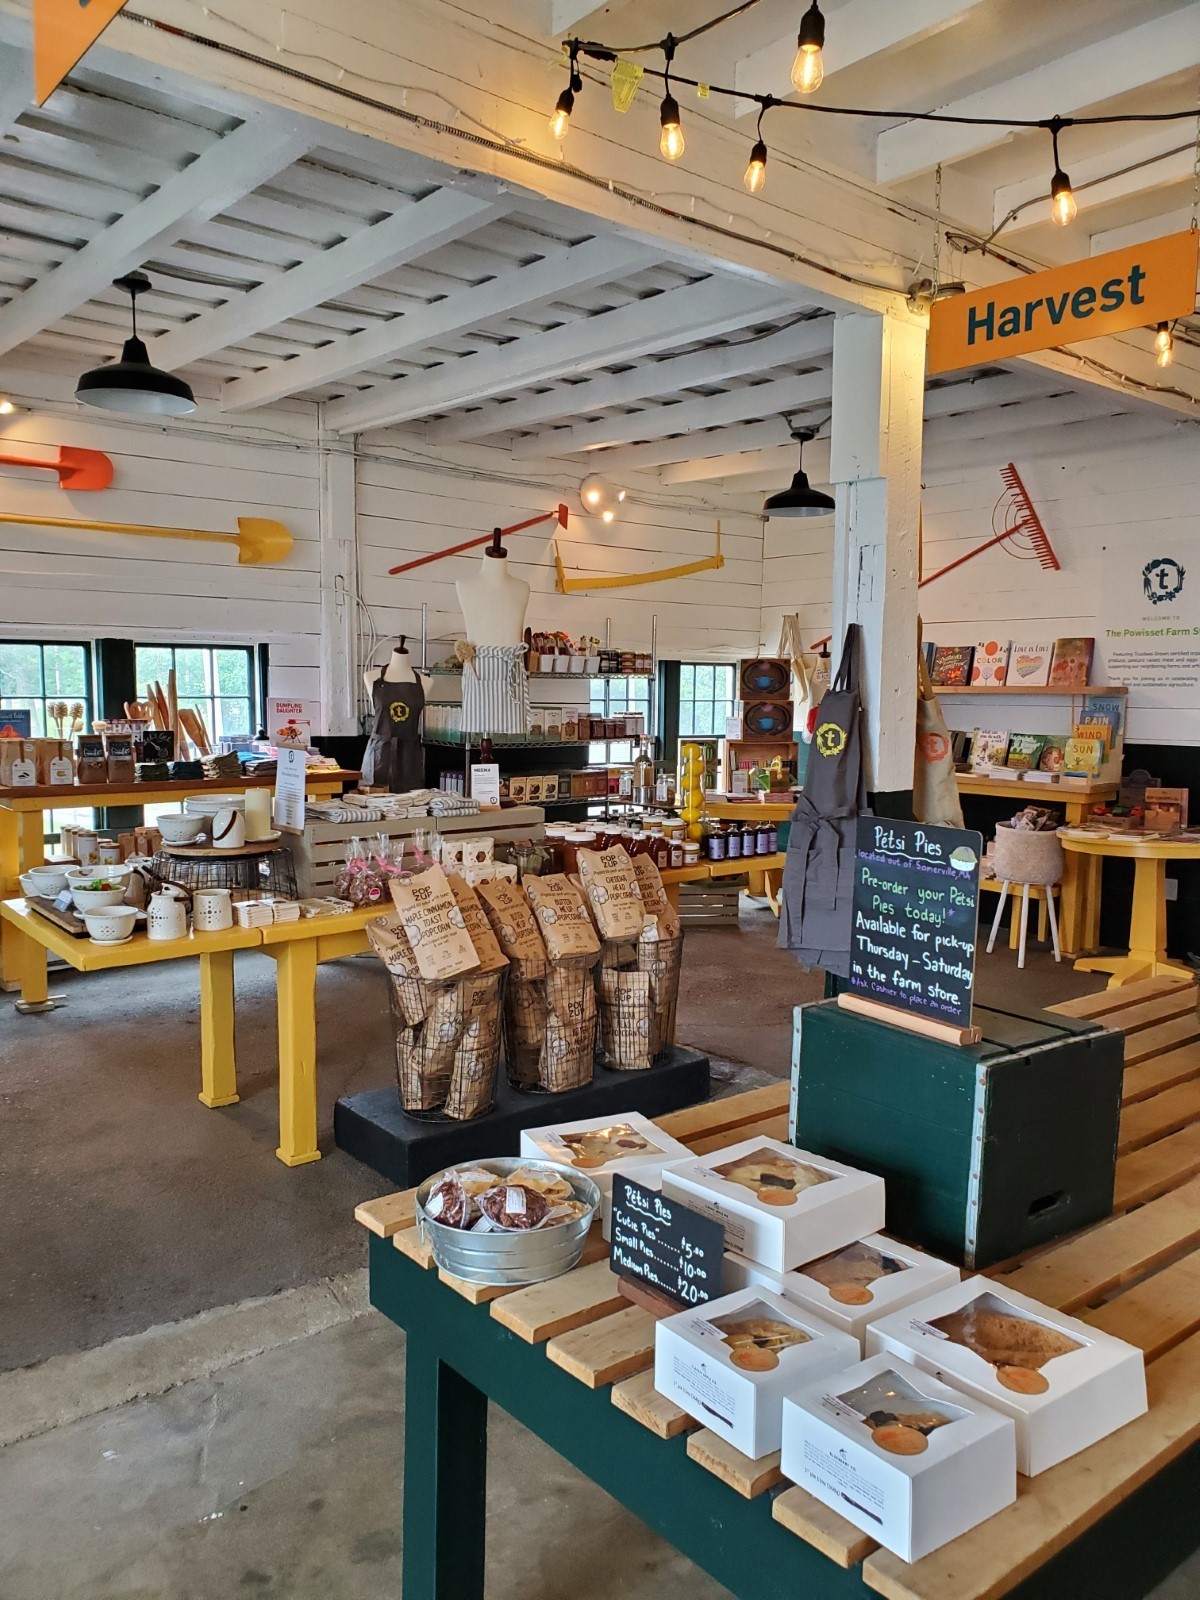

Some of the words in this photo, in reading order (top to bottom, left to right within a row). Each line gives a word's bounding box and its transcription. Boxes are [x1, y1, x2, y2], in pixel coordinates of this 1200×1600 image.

[967, 264, 1146, 346] Harvest
[1105, 629, 1121, 637] The
[1123, 628, 1164, 637] Powisset
[1166, 627, 1190, 636] Farm
[1092, 703, 1120, 711] SNOW
[1085, 716, 1109, 725] RAIN
[1077, 731, 1102, 739] WIND
[1073, 745, 1093, 754] SUN
[914, 830, 942, 856] Pies
[600, 855, 617, 863] POP
[858, 849, 885, 863] located
[887, 857, 900, 866] out
[903, 860, 912, 868] of
[605, 875, 628, 883] CHEDDAR
[861, 867, 908, 895] Pre-order
[918, 888, 945, 904] your
[412, 885, 431, 896] POP
[414, 891, 433, 901] ZUP
[609, 891, 634, 901] POPCORN
[405, 910, 423, 924] MAPLE
[423, 900, 453, 917] CINNAMON
[872, 895, 894, 915] Pies
[905, 902, 946, 928] today!
[390, 925, 404, 934] PO
[423, 914, 442, 928] TOAST
[395, 931, 408, 940] ZU
[421, 922, 451, 939] POPCORN
[856, 910, 906, 938] Available
[911, 924, 931, 942] for
[935, 935, 974, 958] pick-up
[389, 948, 407, 963] MAPLE
[856, 935, 909, 970] Thursday
[922, 952, 973, 989] Saturday
[852, 961, 862, 975] in
[867, 964, 887, 982] the
[892, 970, 921, 993] farm
[928, 983, 961, 1005] store.
[900, 991, 907, 999] to
[909, 996, 927, 1005] place
[929, 1000, 938, 1008] an
[940, 1004, 962, 1016] order
[654, 1198, 672, 1220] Pies
[615, 1227, 638, 1250] Small
[679, 1256, 707, 1279] $10.00
[681, 1236, 704, 1259] $5.00
[613, 1245, 643, 1276] Medium
[677, 1275, 709, 1303] $20.00
